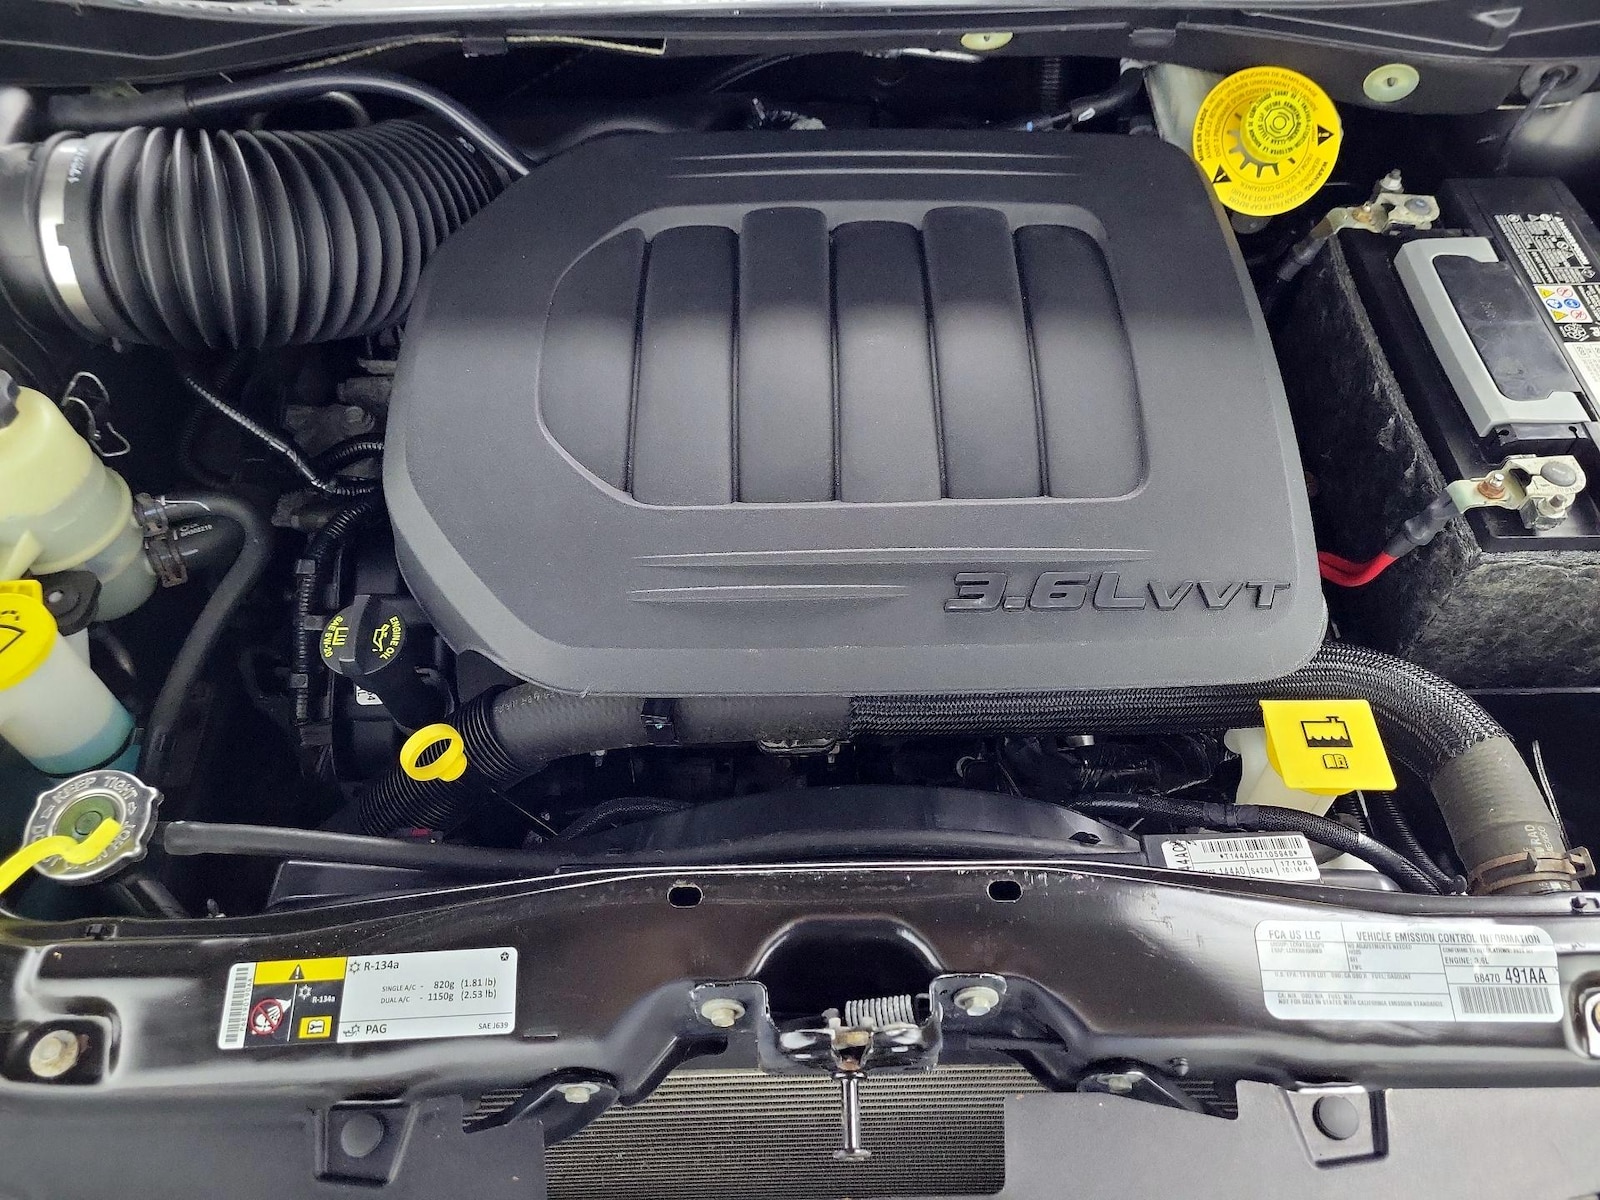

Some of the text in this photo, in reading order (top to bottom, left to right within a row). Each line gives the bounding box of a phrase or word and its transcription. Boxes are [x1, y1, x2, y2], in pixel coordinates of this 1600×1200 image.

[944, 571, 1291, 612] 3.6L VVT
[327, 615, 344, 632] SAE
[379, 616, 402, 660] ENGINE OIL
[52, 775, 139, 803] KEEP TIGHT
[1268, 930, 1321, 940] FCA US LLC
[1356, 931, 1392, 942] VEHICLE
[1395, 932, 1435, 943] EMISSION
[1438, 934, 1477, 943] CONTROL
[363, 960, 399, 971] R-134a
[1445, 957, 1473, 965] ENGINE:
[1474, 973, 1501, 983] 68470
[1505, 967, 1548, 984] 491AA
[433, 980, 455, 990] 820g
[460, 978, 482, 990] (1.81
[484, 977, 497, 988] lb)
[311, 995, 336, 1003] R-134a
[380, 996, 398, 1004] DUAL
[427, 993, 454, 1002] 1150g
[460, 990, 483, 1001] (2.53
[485, 989, 497, 999] lb)
[365, 1024, 388, 1034] PAG
[478, 1021, 509, 1030] SAE J639
